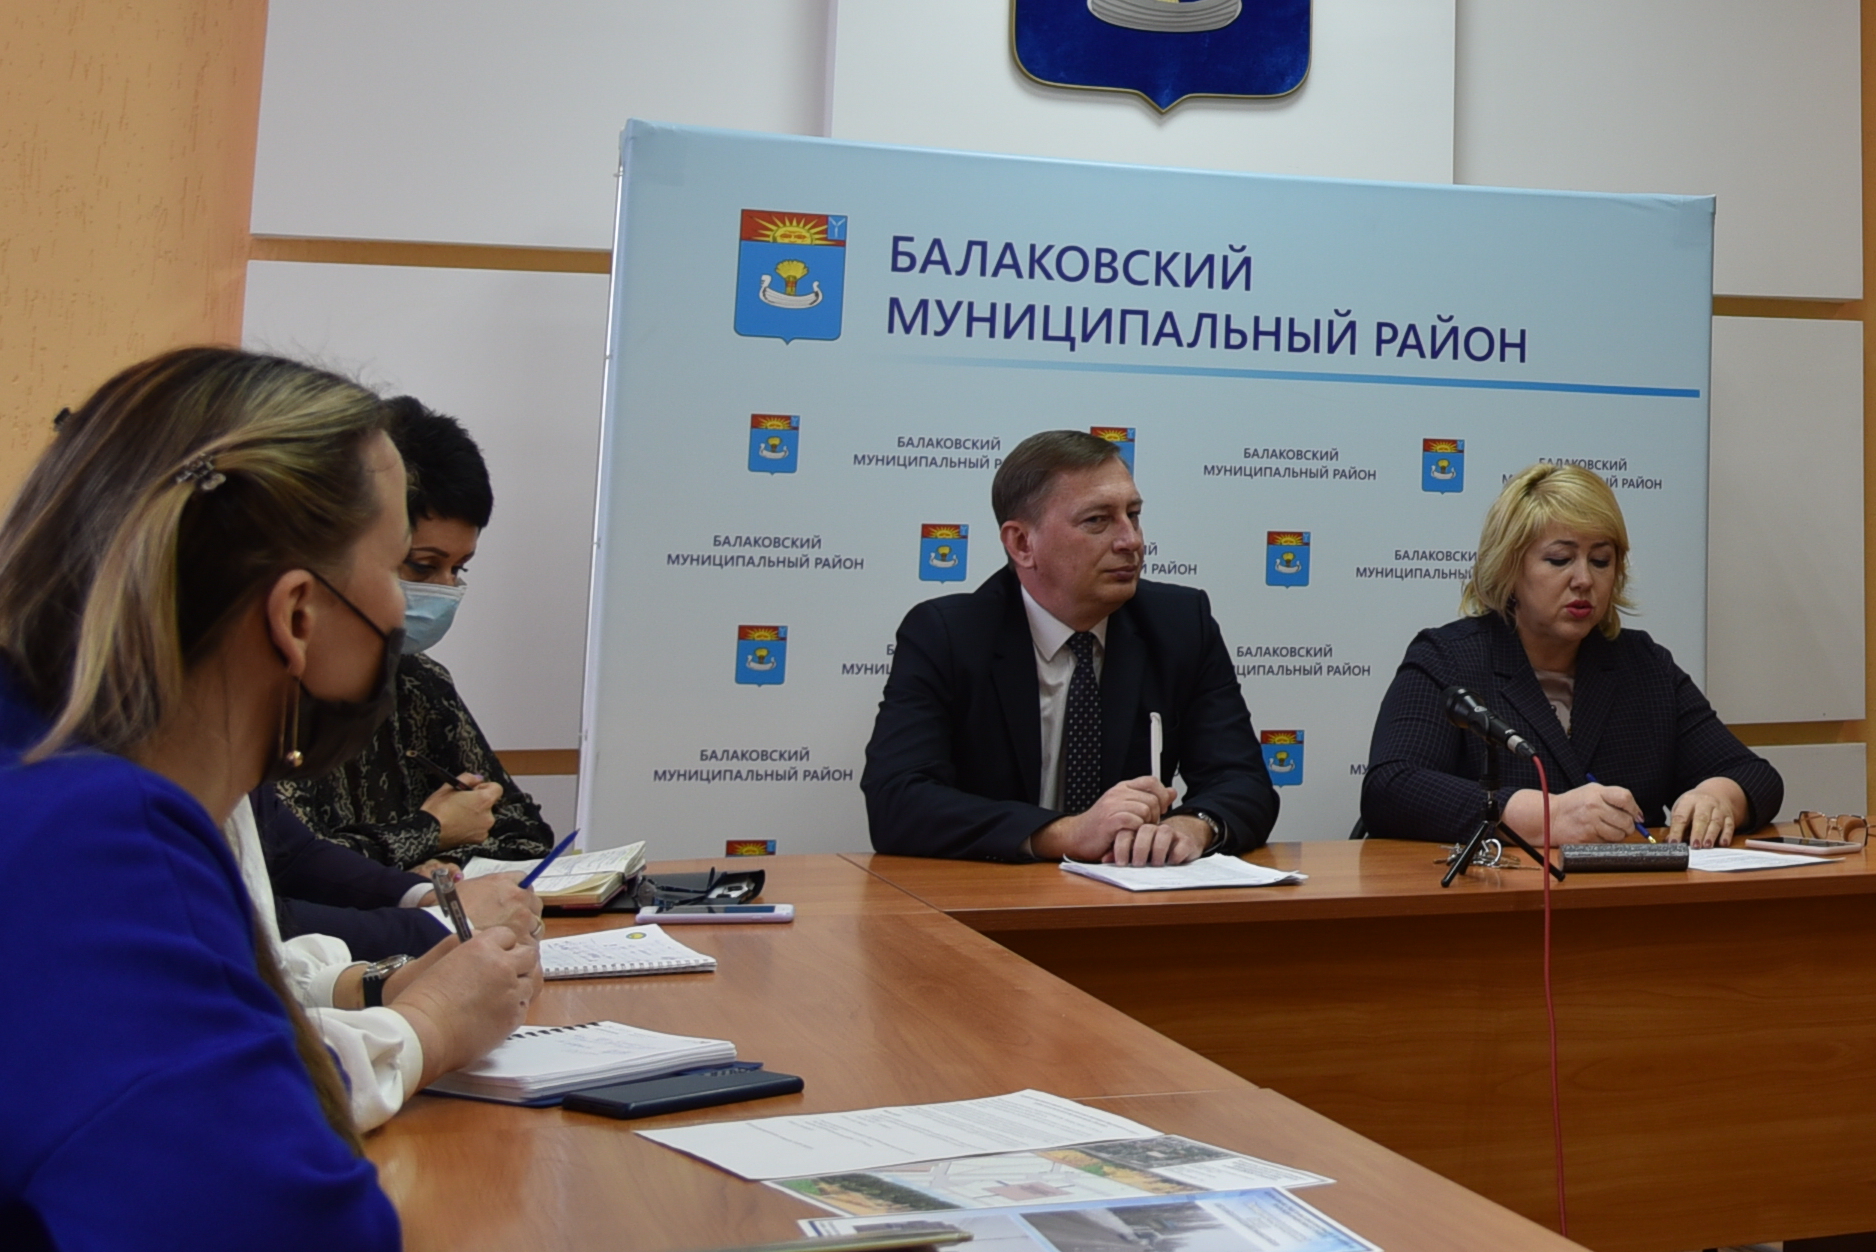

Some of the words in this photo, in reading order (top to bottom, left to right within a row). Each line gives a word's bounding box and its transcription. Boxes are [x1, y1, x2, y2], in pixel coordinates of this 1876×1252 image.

[889, 234, 1254, 292] БАЛАКОВСКИЙ
[886, 296, 1358, 357] МУНИЦИПАЛЬНЫЙ
[1374, 314, 1528, 364] РАЙОН
[896, 435, 1002, 452] БАЛАКОВСКИЙ
[852, 453, 990, 470] МУНИЦИПАЛЬНЫЙ
[1243, 447, 1340, 462] БАЛАКОВСКИЙ
[1202, 464, 1329, 480] МУНИЦИПАЛЬНЫЙ
[1332, 466, 1377, 481] РАЙОН
[1621, 476, 1663, 490] РАЙОН
[712, 534, 822, 550] БАЛАКОВСКИЙ
[666, 552, 811, 571] МУНИЦИПАЛЬНЫЙ
[814, 556, 865, 571] РАЙОН
[1394, 549, 1477, 562] БАЛАКОВСКИ
[1151, 560, 1198, 576] РАЙОН
[1236, 644, 1333, 658] БАЛАКОВСКИЙ
[1234, 661, 1323, 678] ЦИПАЛЬНЫЙ
[1326, 662, 1371, 677] РАЙОН
[699, 746, 810, 762] БАЛАКОВСКИЙ
[653, 766, 798, 784] МУНИЦИПАЛЬНЫЙ
[802, 766, 853, 782] РАЙОН
